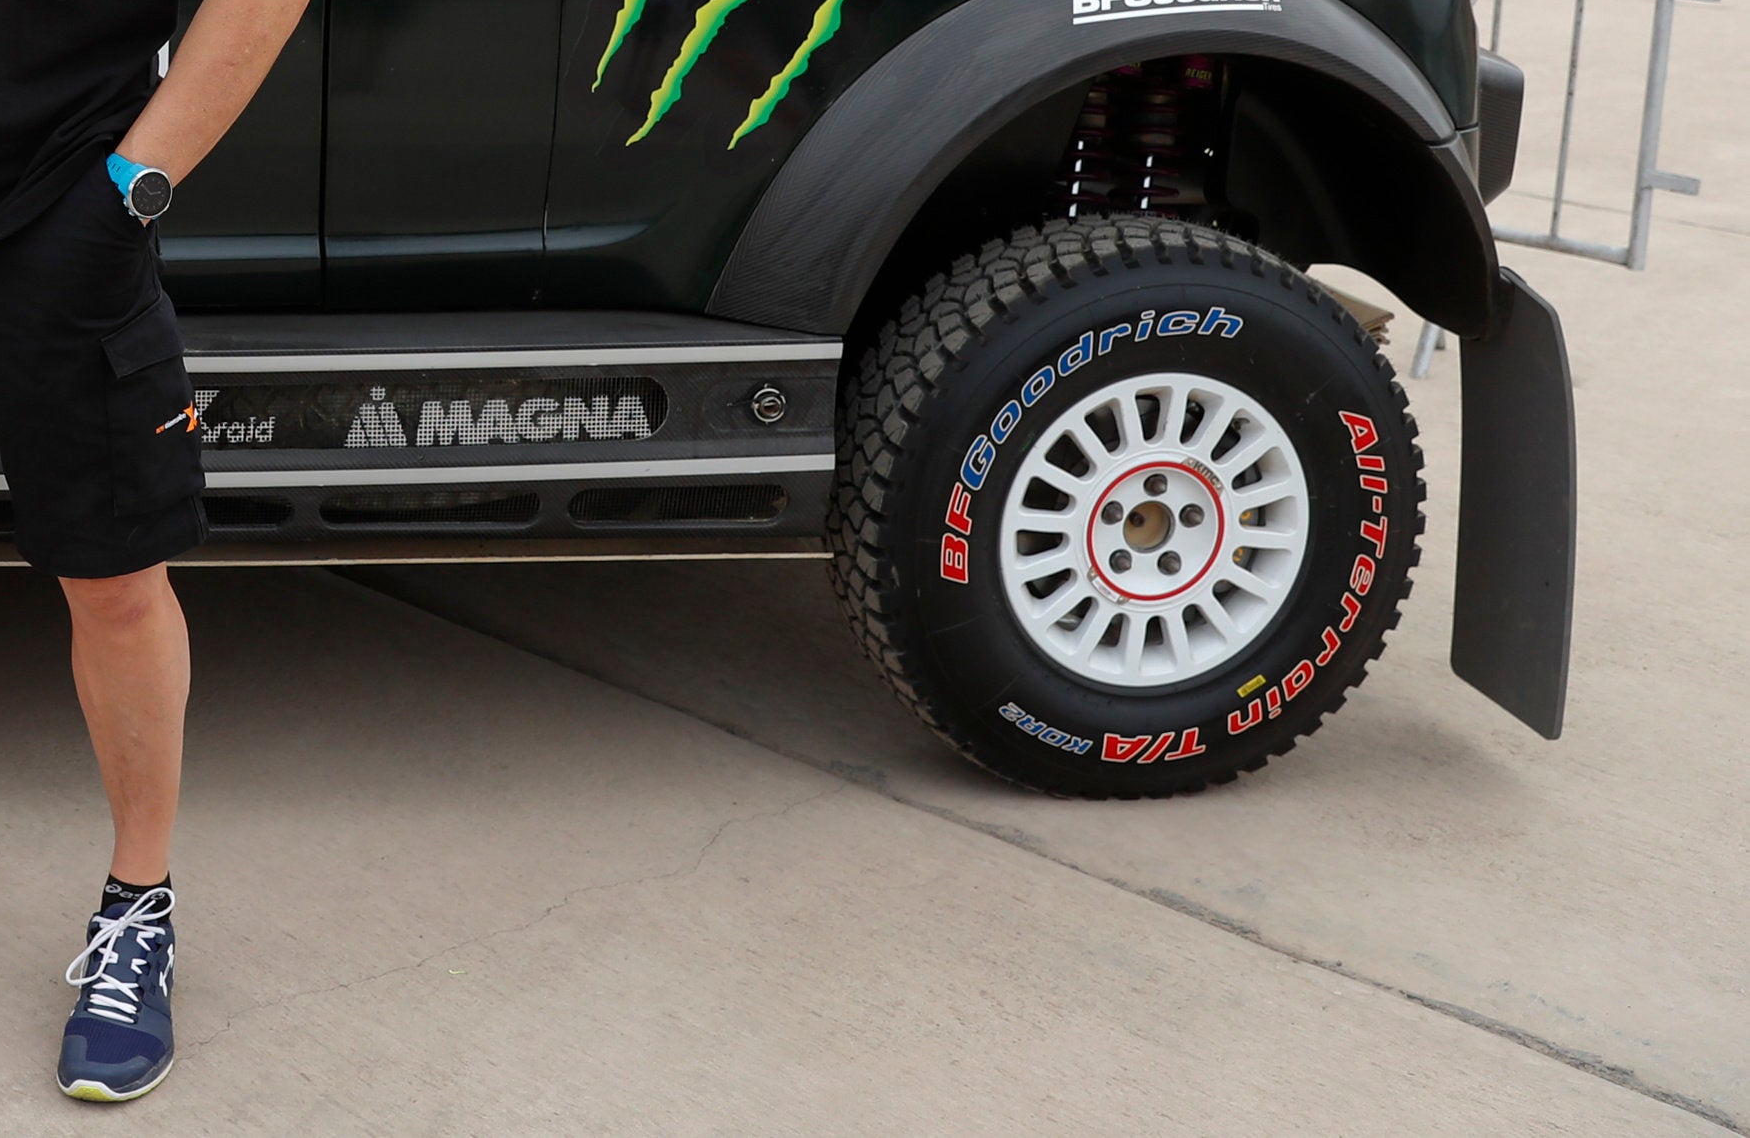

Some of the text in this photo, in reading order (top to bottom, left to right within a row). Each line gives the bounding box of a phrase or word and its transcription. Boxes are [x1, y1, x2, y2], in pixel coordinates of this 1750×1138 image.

[415, 395, 652, 447] MAGNA
[939, 307, 1245, 585] BFGoodrich
[1227, 409, 1389, 737] All-Terrain
[1100, 727, 1206, 764] T/A
